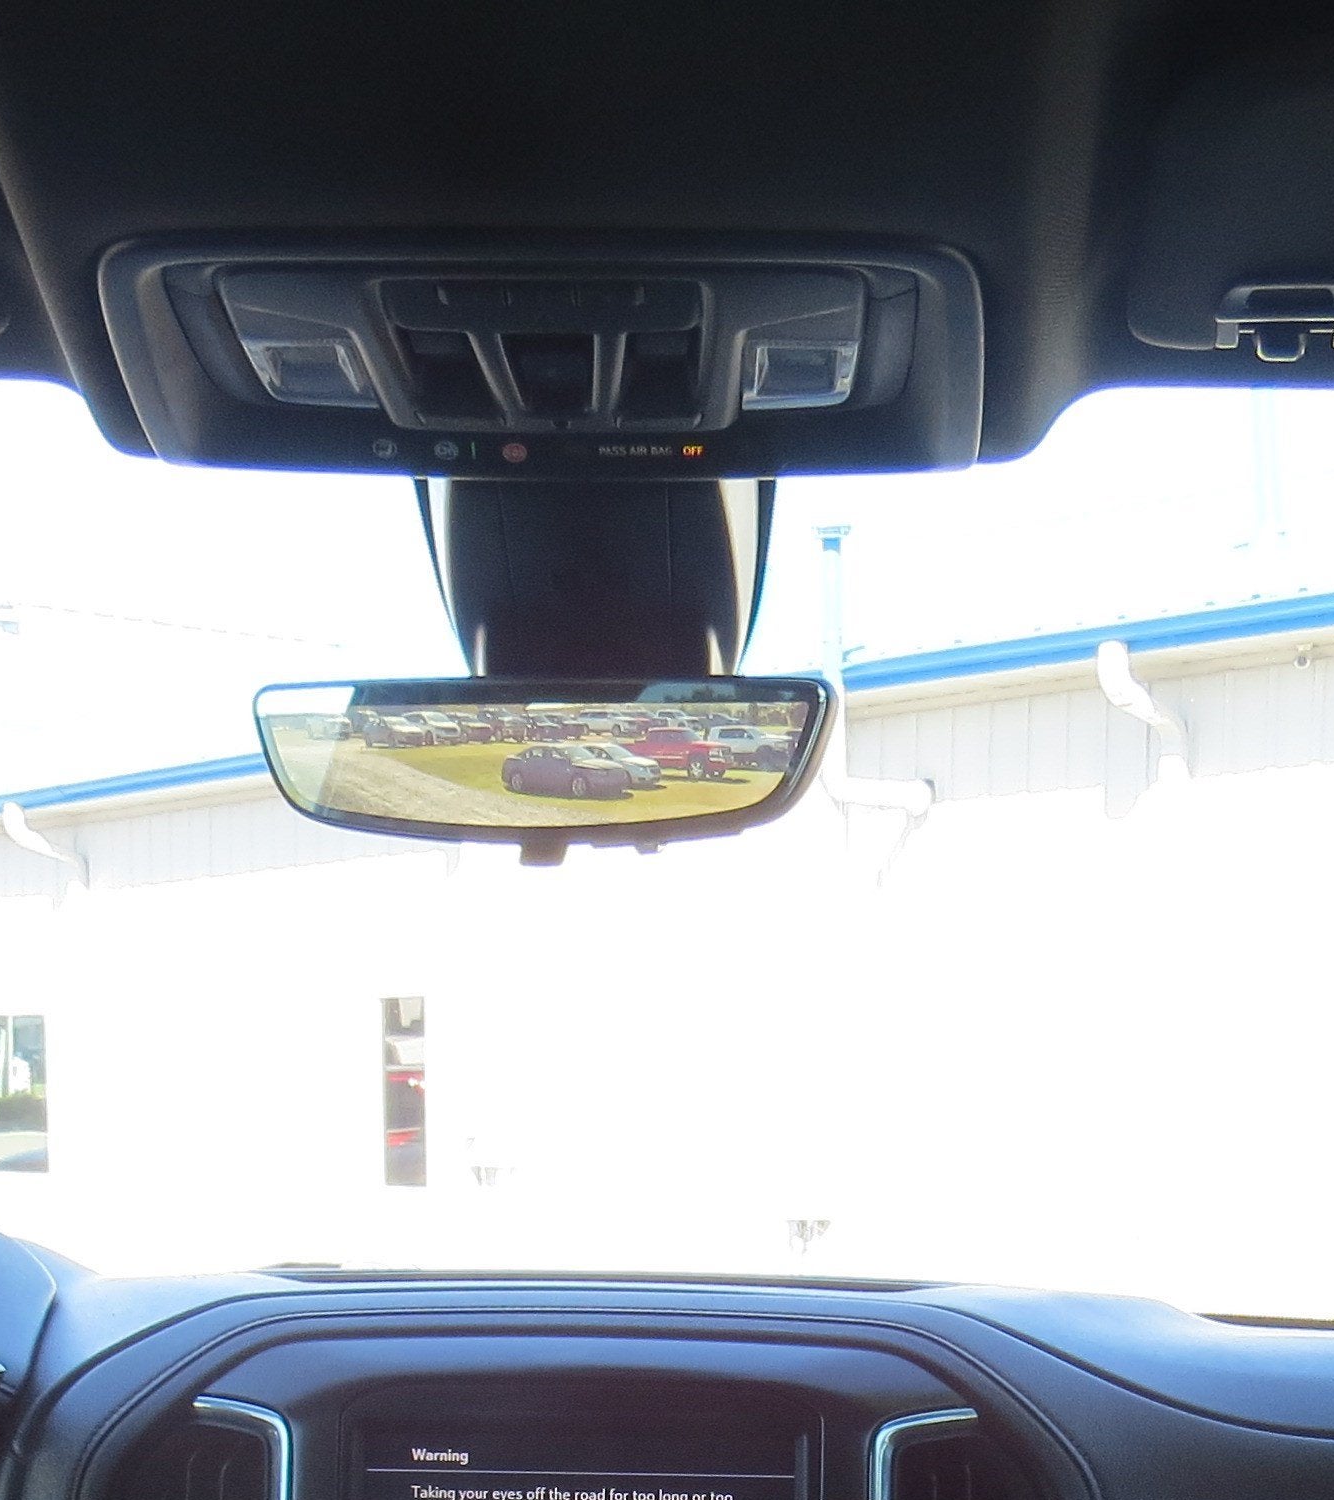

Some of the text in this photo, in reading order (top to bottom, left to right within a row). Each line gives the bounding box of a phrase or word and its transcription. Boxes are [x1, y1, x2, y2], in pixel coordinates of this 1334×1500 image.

[681, 445, 705, 457] OFF
[411, 1447, 469, 1466] Warning
[526, 1486, 546, 1500] off
